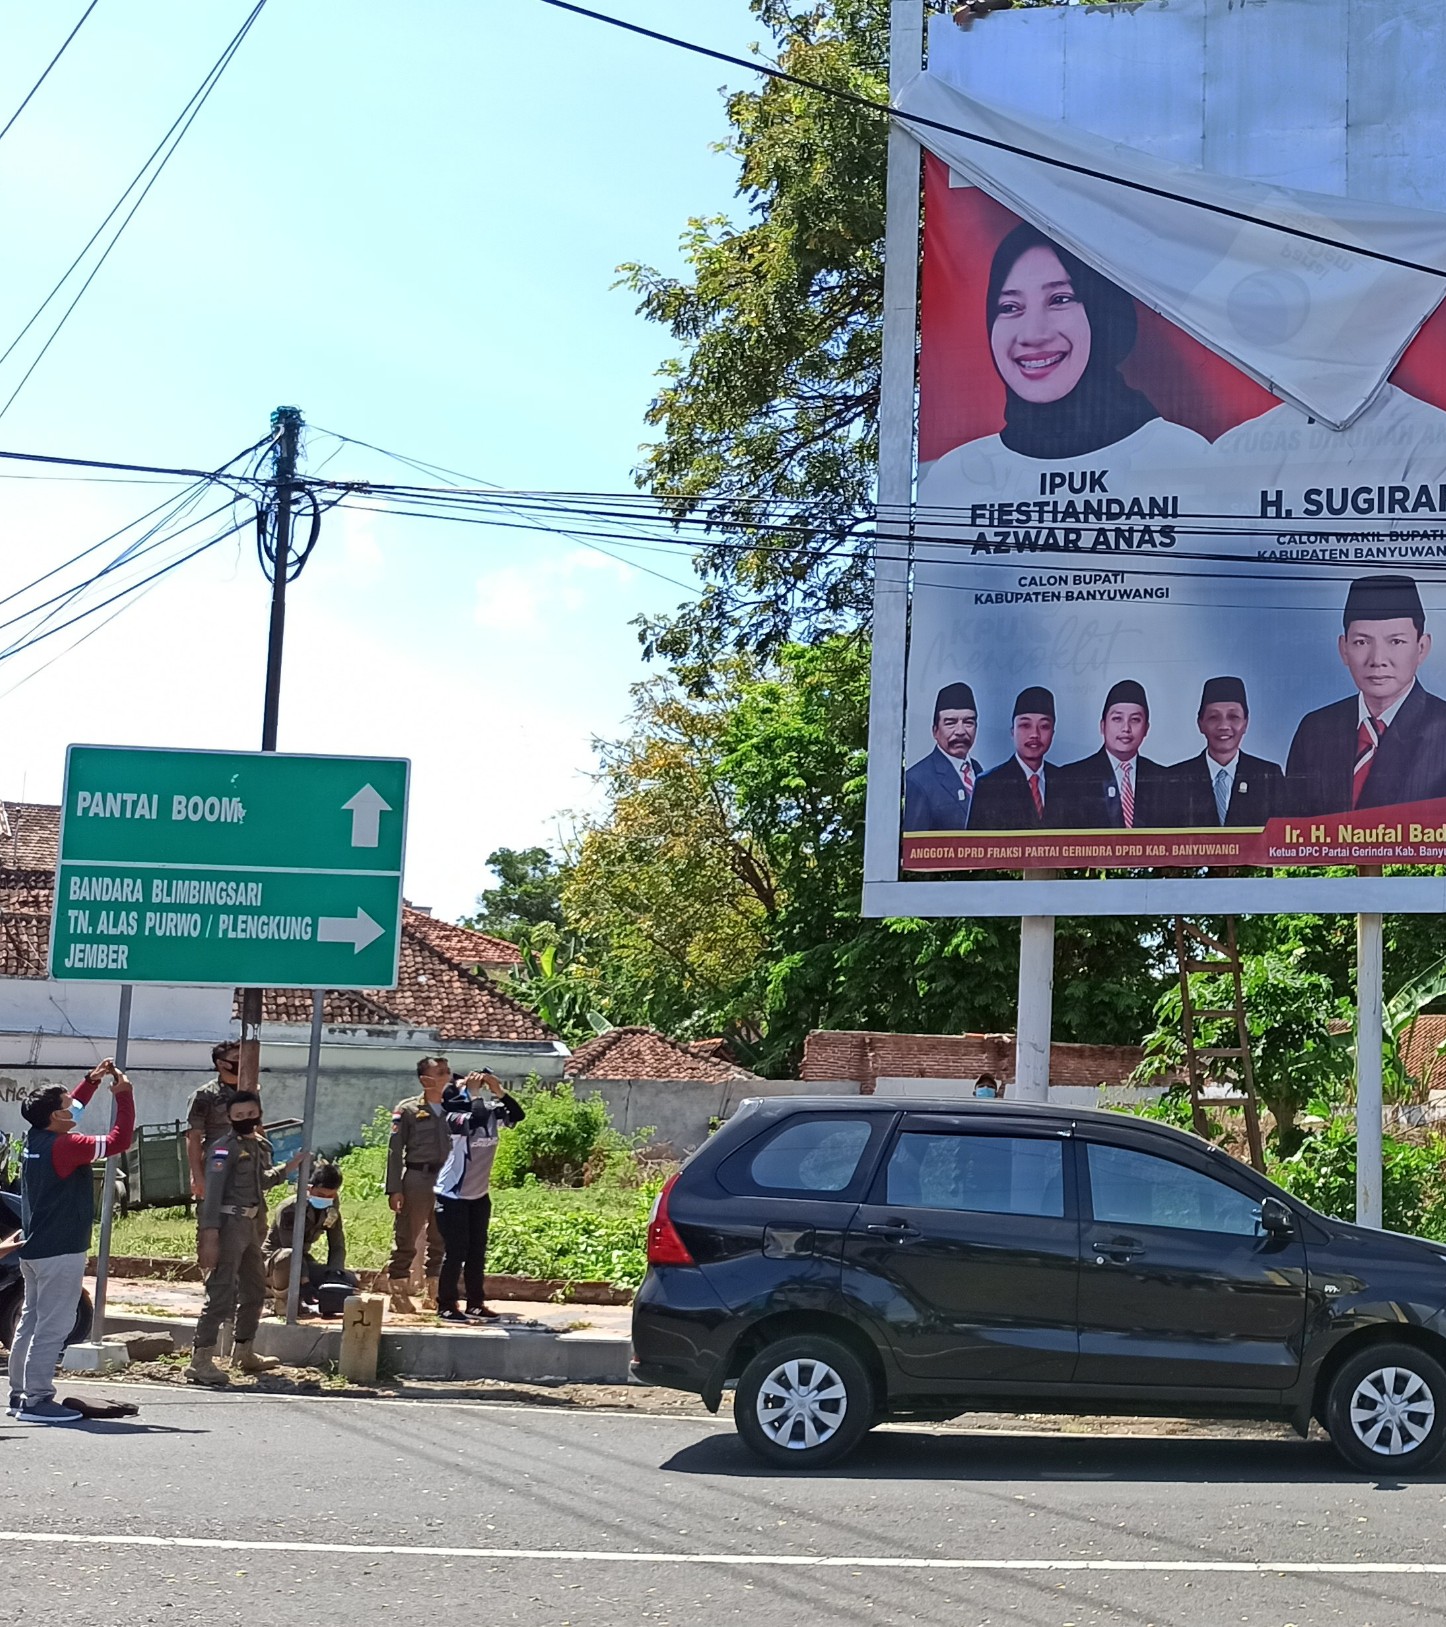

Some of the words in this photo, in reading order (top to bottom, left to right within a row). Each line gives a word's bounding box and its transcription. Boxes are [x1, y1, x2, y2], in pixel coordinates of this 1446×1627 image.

[1040, 470, 1109, 496] IPUK
[1260, 490, 1293, 517] H.
[970, 528, 1083, 555] AZWAR
[1090, 525, 1177, 552] ANAS
[1276, 531, 1330, 546] CALON
[1335, 530, 1385, 545] WAKIL
[1389, 529, 1445, 543] BUPATI
[1257, 548, 1350, 562] KABUPATEN
[1018, 574, 1069, 588] CALON
[1072, 572, 1125, 586] BUPATI
[974, 591, 1061, 605] KABUPATEN
[1065, 587, 1170, 602] BANYUWANGI
[76, 791, 159, 821] PANTAI
[171, 795, 242, 823] BOOM
[1285, 825, 1304, 843] Ir.
[1310, 824, 1331, 843] H.
[1338, 823, 1402, 843] Naufal
[910, 846, 955, 860] ANGGOTA
[958, 846, 985, 859] DPRD
[987, 845, 1022, 858] FRAKSI
[1025, 845, 1060, 858] PARTAI
[1062, 845, 1113, 857] GERINDRA
[1115, 844, 1143, 857] DPRD
[1145, 844, 1169, 856] KAB.
[1172, 843, 1240, 856] BANYUWANGI
[1269, 847, 1297, 858] Ketua
[1298, 847, 1320, 858] DPC
[1322, 846, 1350, 858] Partai
[1351, 846, 1393, 857] Gerindra
[1395, 845, 1417, 857] Kab.
[69, 876, 143, 903] BANDARA
[151, 880, 263, 907] BLIMBINGSARI
[68, 909, 93, 935] TN.
[96, 910, 138, 936] ALAS
[144, 911, 201, 938] PURWO
[205, 914, 214, 938] /
[218, 914, 313, 941] PLENGKUNG
[64, 943, 129, 970] JEMBER
